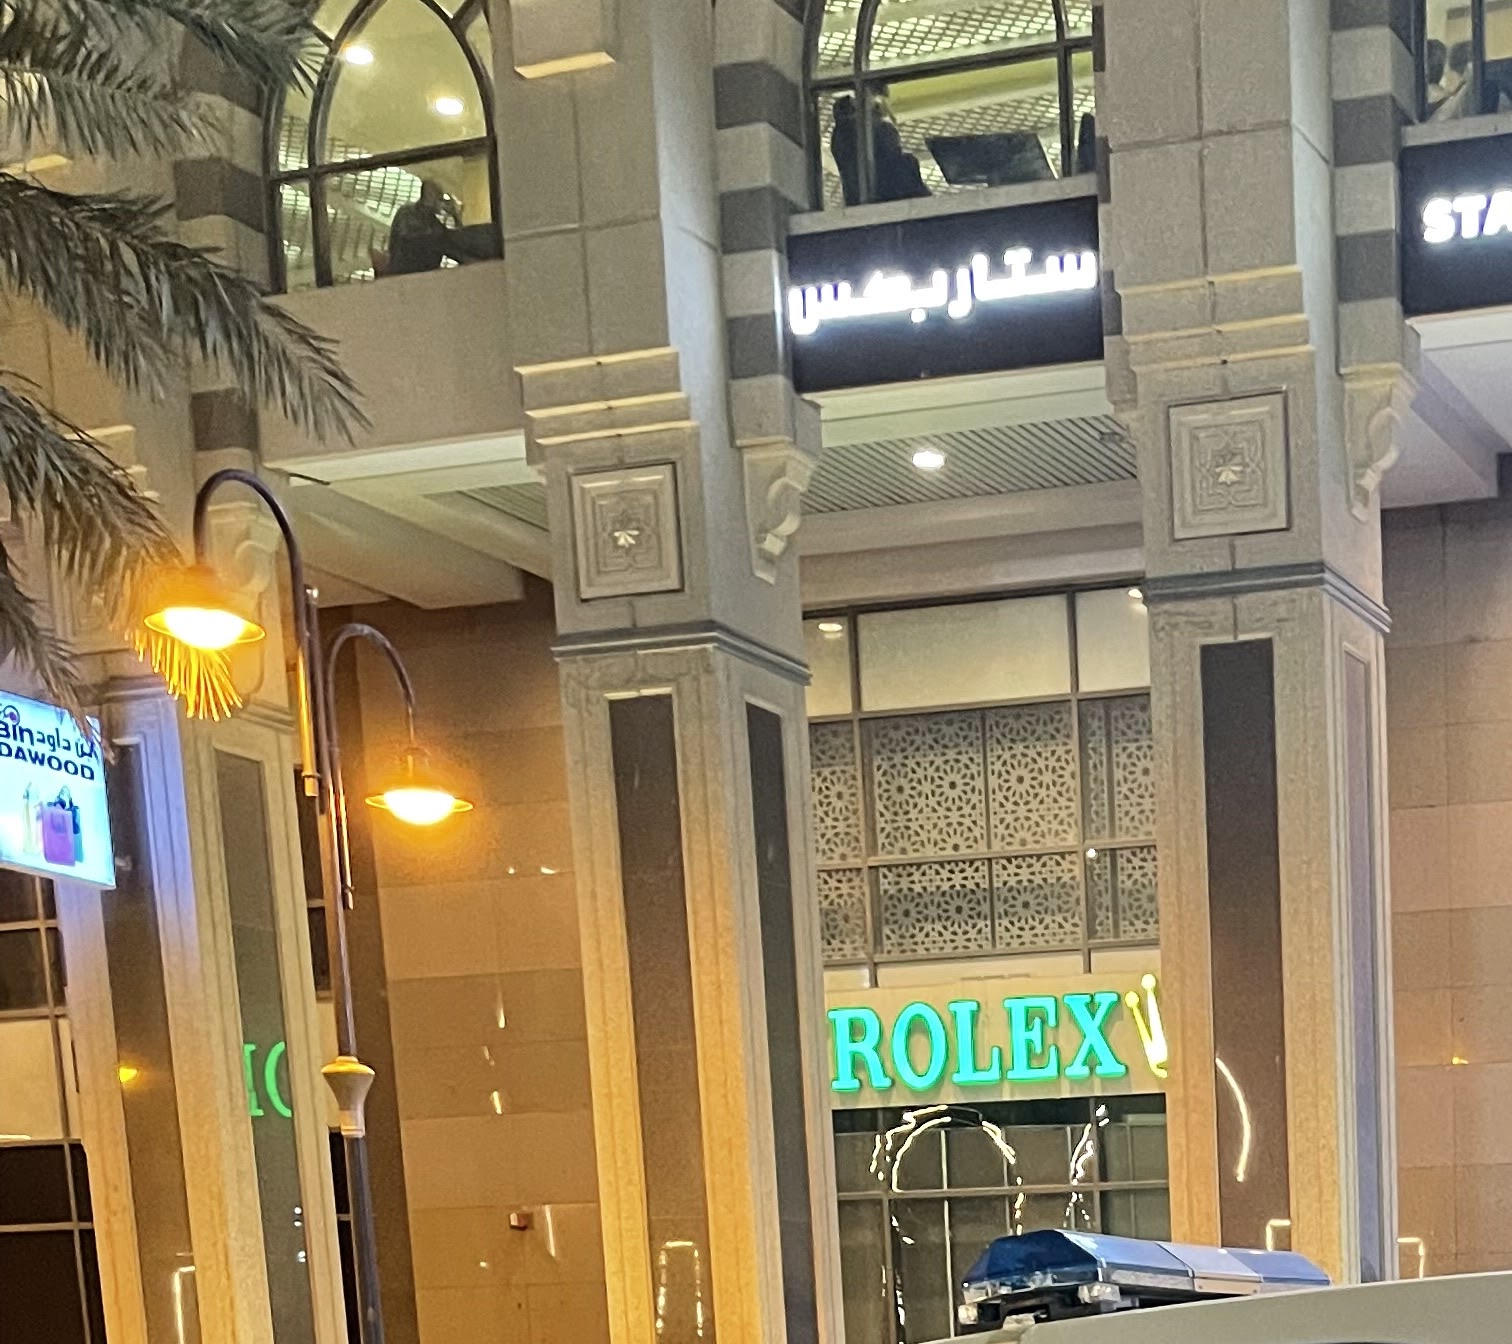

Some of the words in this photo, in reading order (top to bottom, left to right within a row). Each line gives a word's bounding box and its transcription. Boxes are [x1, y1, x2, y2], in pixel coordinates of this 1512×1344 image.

[788, 247, 1097, 336] ستاربكس
[0, 742, 95, 781] DAWOOD
[827, 991, 1128, 1092] ROLEX
